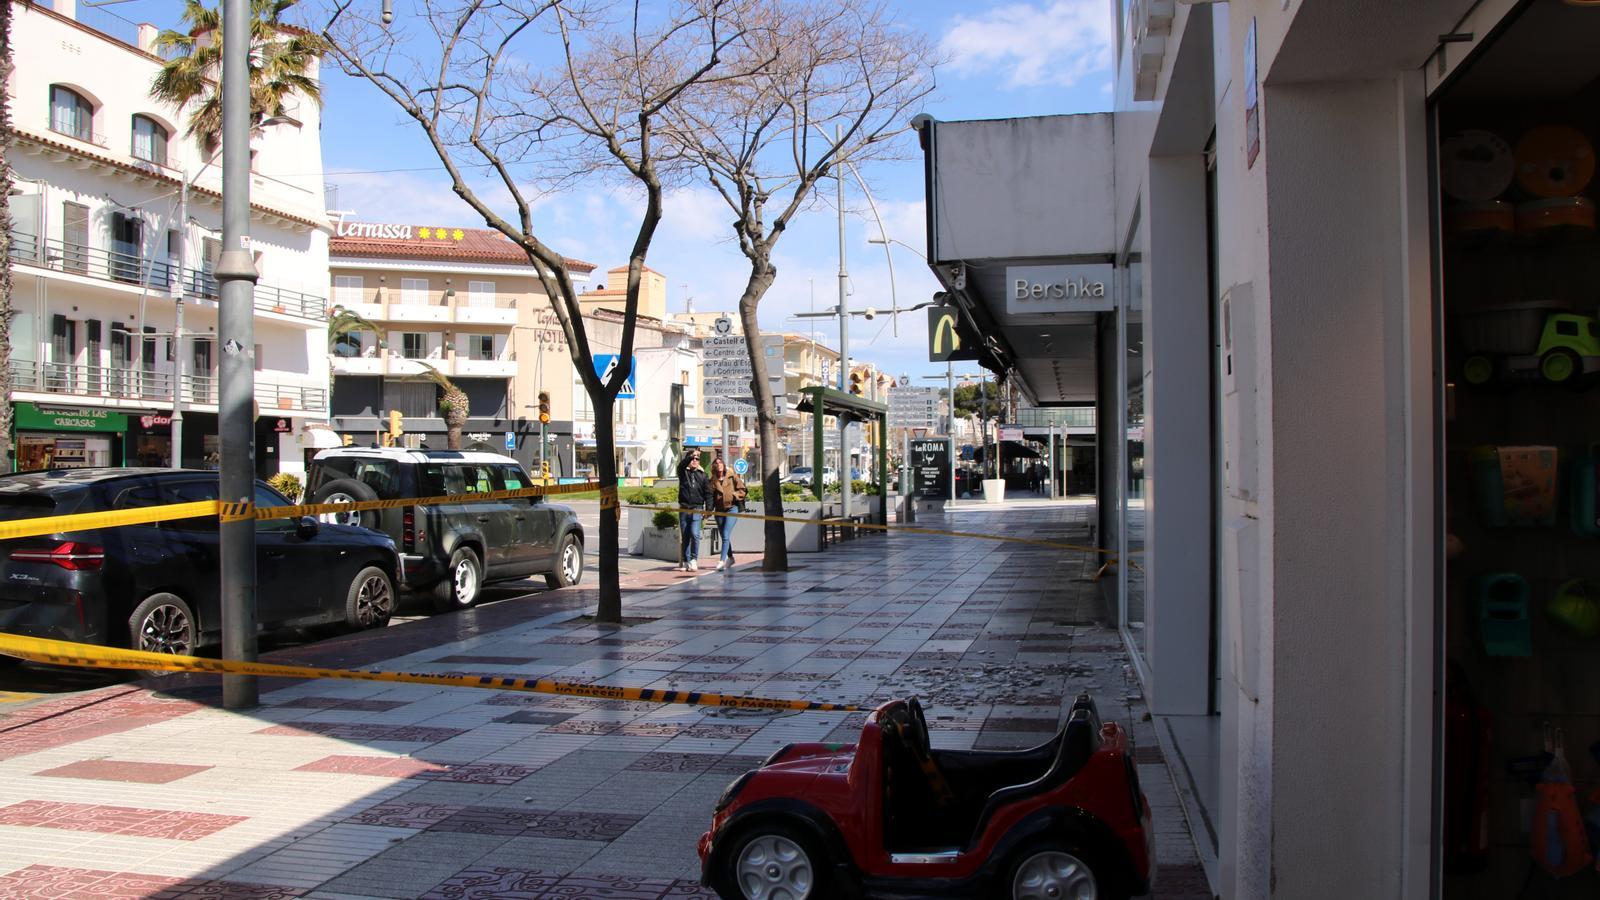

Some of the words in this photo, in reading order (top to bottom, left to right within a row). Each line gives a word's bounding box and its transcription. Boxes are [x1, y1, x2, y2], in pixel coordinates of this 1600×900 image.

[326, 210, 413, 239] Terrassa
[1015, 277, 1105, 299] Bershka
[733, 360, 752, 368] d'Esp
[717, 368, 752, 376] Congresso
[54, 417, 96, 427] CARCASAS
[922, 442, 944, 452] ROMA
[720, 699, 738, 707] NO
